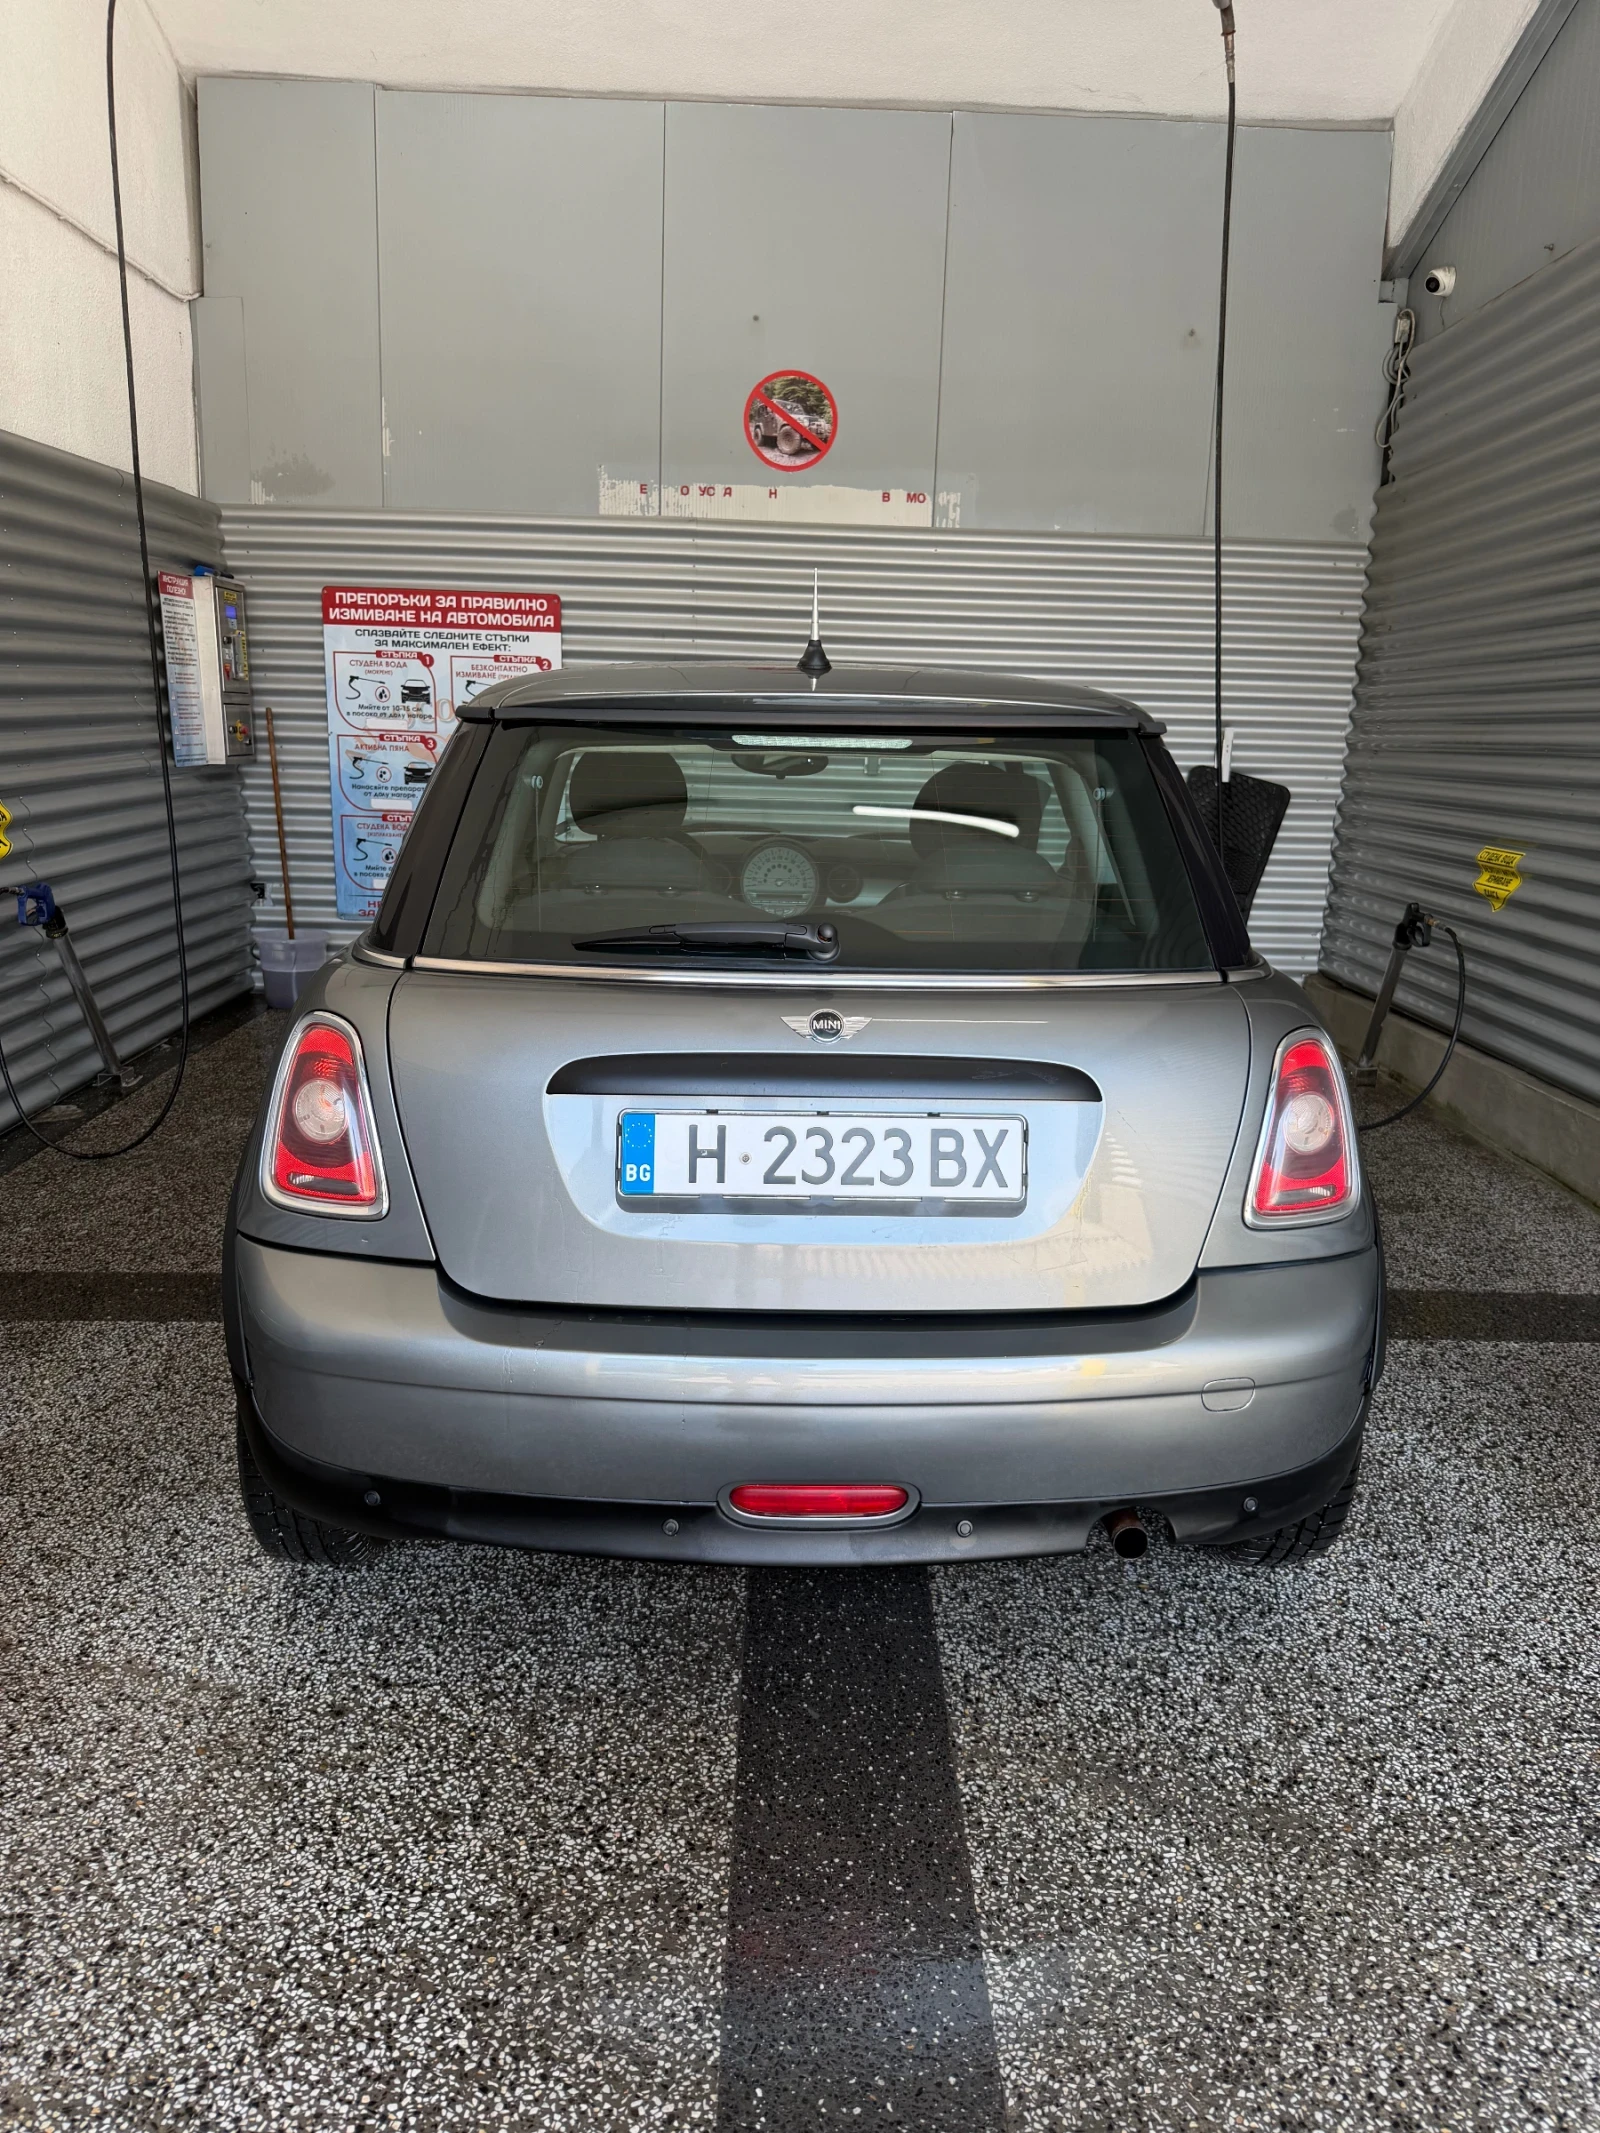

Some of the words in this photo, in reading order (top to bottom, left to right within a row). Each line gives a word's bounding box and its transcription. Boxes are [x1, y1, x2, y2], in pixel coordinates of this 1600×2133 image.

[335, 592, 431, 607] ПРЕПОРЪКИ
[435, 595, 456, 608] ЗА
[461, 596, 548, 611] ПРАВИЛНО
[329, 607, 416, 622] ИЗМИВАНЕ
[420, 610, 442, 623] НА
[446, 611, 554, 627] АВТОМОБИЛА
[355, 628, 421, 639] СПАЗВАЙТЕ
[423, 631, 482, 641] СЛЕДНИТЕ
[485, 633, 530, 643] СТЪПКИ
[374, 639, 388, 648] ЗА
[391, 639, 469, 650] МАКСИМАЛЕН
[472, 642, 512, 652] ЕФЕКТ:
[349, 659, 383, 667] СТУДЕНА
[380, 650, 418, 659] СТЪПКА
[425, 656, 430, 665] 1
[499, 655, 537, 664] СТЪПКА
[542, 660, 549, 670] 2
[455, 671, 496, 679] ИЗМИВАНЕ
[471, 664, 528, 673] БЕЗКОНТАКТНО
[383, 734, 420, 742] СТЪПКА
[427, 739, 434, 748] 3
[354, 744, 387, 752] АКТИВНА
[387, 814, 411, 822] СТЪП
[356, 822, 390, 830] СТУДЕНА
[812, 1019, 841, 1030] MINI
[688, 1124, 726, 1184] H
[763, 1126, 915, 1186] 2323
[930, 1128, 1009, 1188] BX
[625, 1163, 652, 1182] BG
